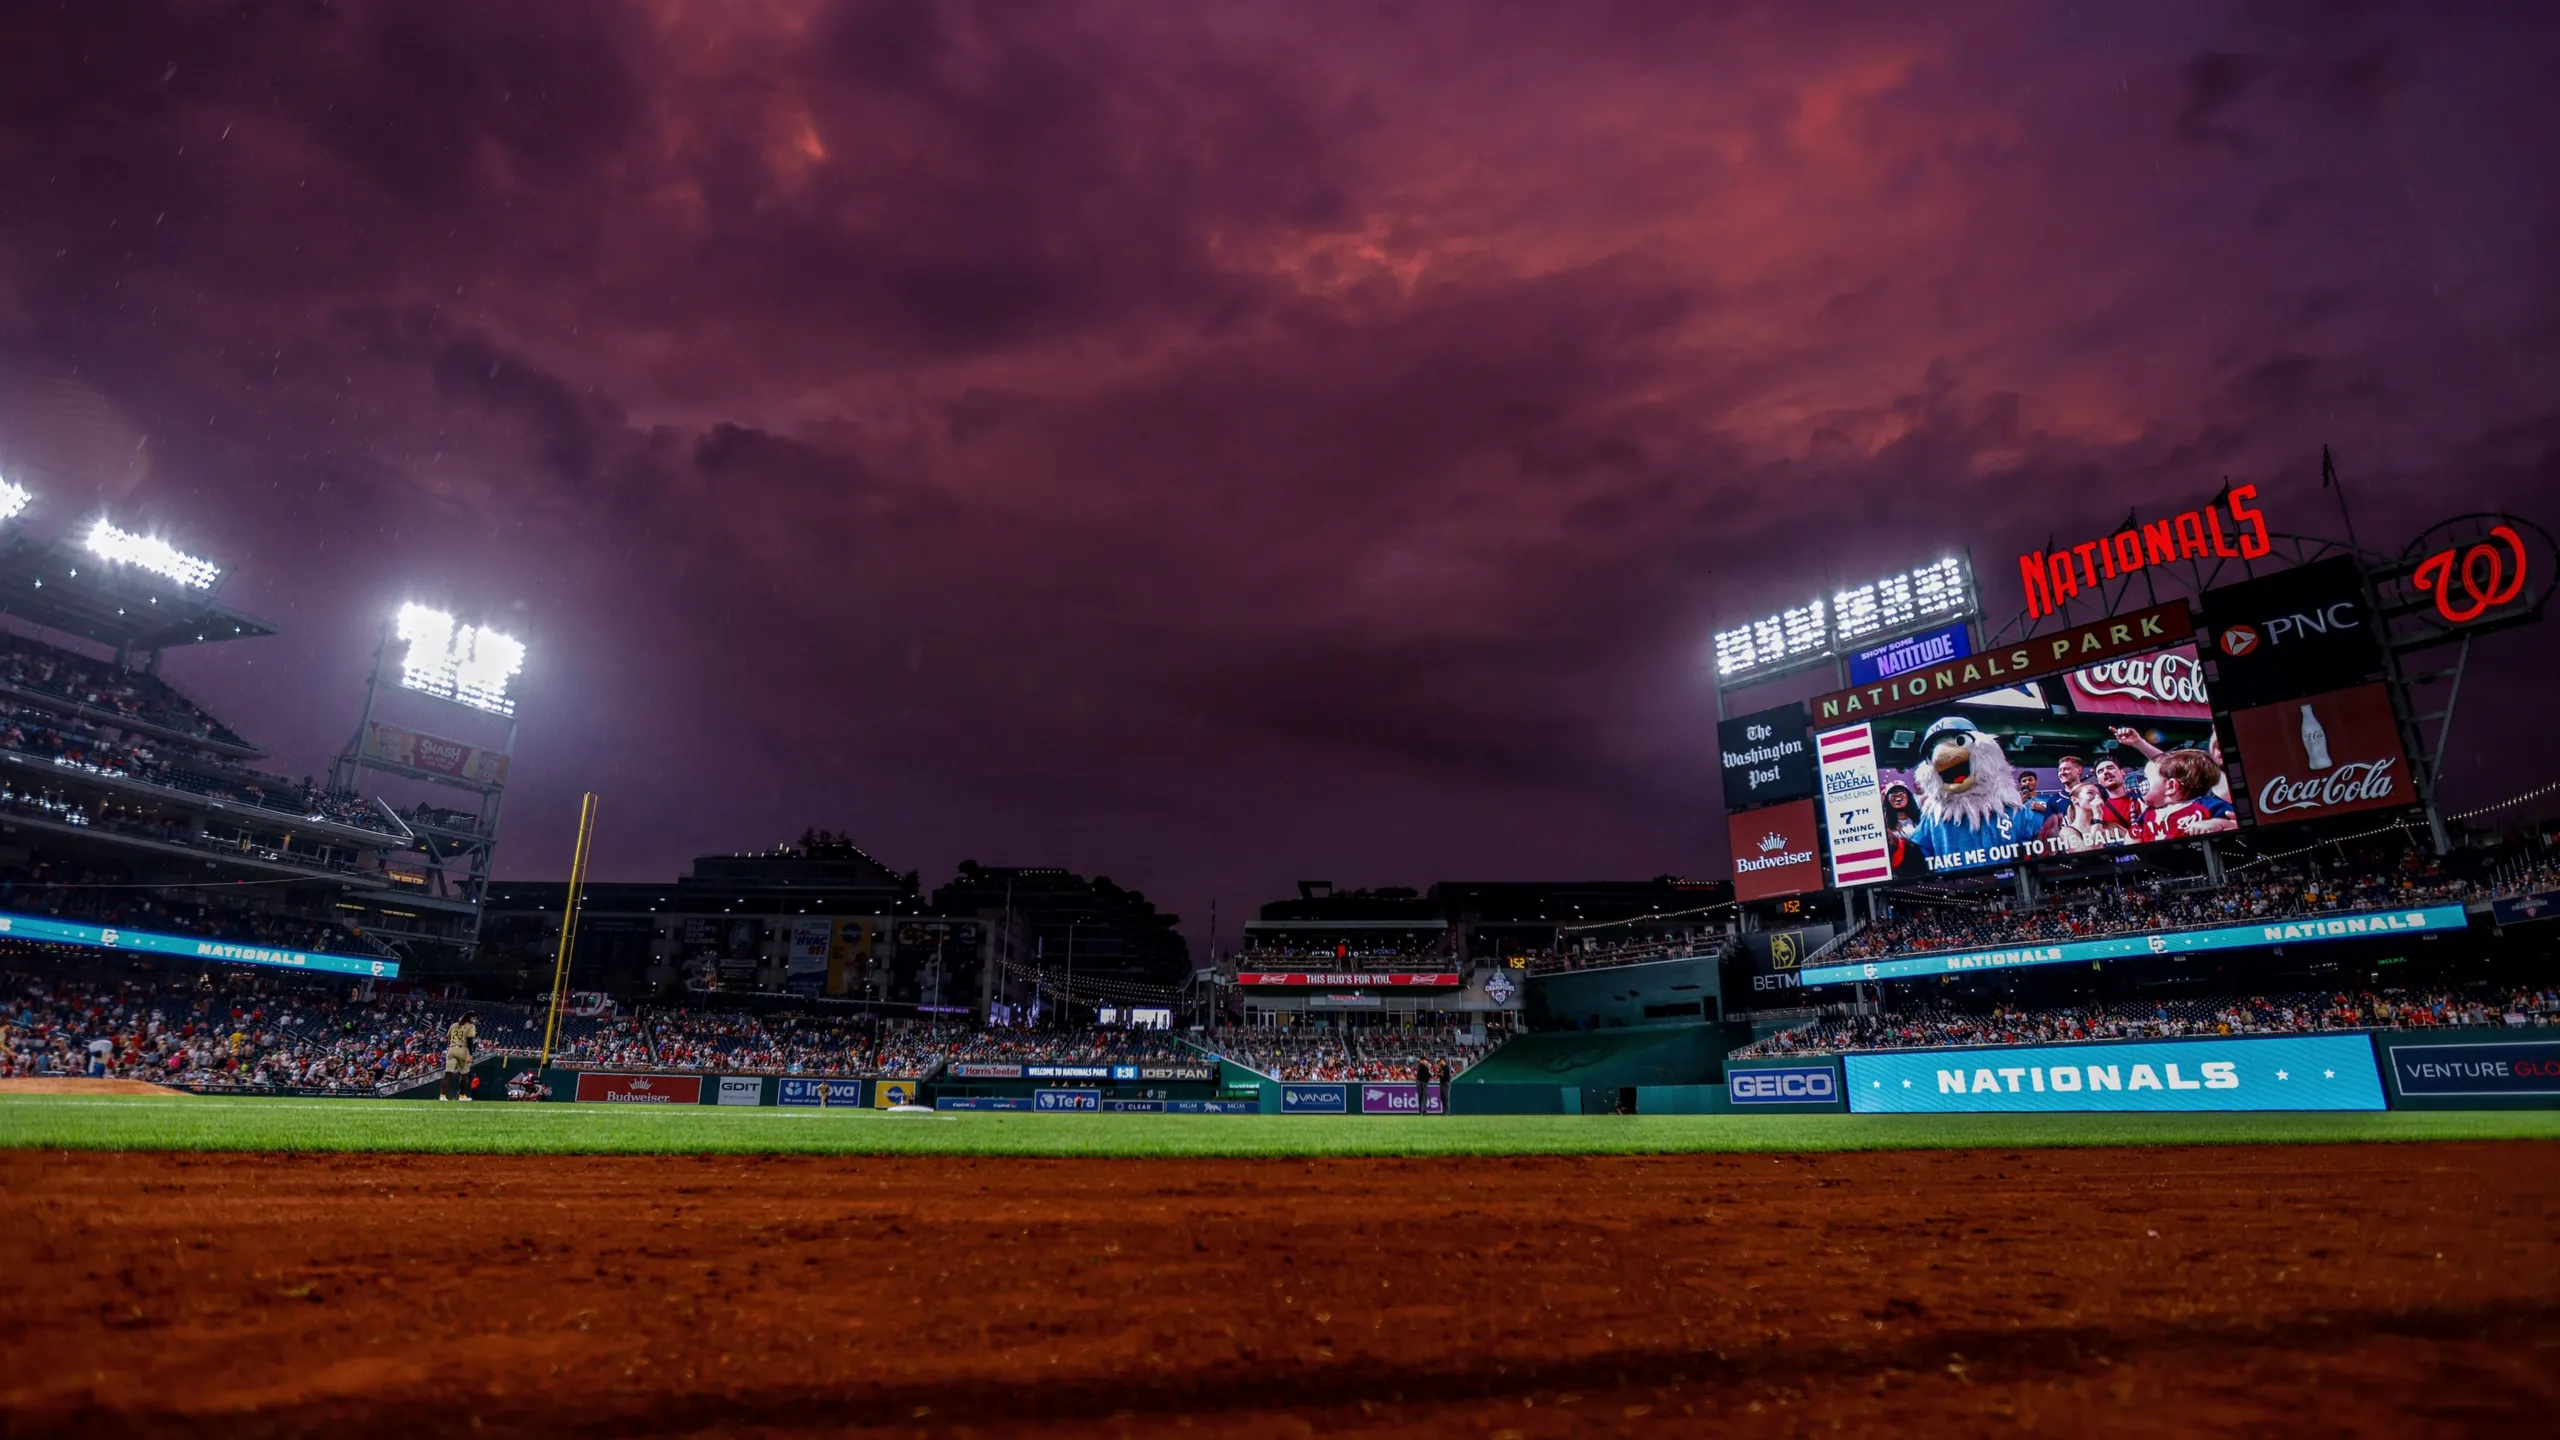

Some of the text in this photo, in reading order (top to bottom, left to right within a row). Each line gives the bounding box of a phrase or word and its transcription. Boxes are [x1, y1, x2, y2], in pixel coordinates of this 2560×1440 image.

[2019, 484, 2271, 620] NATIONALS
[2413, 525, 2527, 623] W
[2261, 602, 2359, 645] PNC
[1861, 637, 1914, 660] SHOW SOME
[1877, 634, 1954, 677] NATITUDE
[1823, 614, 2165, 719] NATIONALS PARK
[2075, 654, 2208, 704] Coca-Col
[1747, 724, 1772, 741] The
[1722, 741, 1803, 768] Washington
[1748, 765, 1781, 790] Post
[1825, 769, 1855, 783] NAVY
[1827, 775, 1874, 792] FEDERAL
[2259, 757, 2396, 814] Coca-Cola
[1828, 788, 1877, 804] Credit Union
[1840, 808, 1869, 825] 7TH
[1833, 831, 1882, 846] STRETCH
[1839, 824, 1875, 835] INNING
[1925, 854, 1962, 871] TAKE
[1965, 849, 1986, 865] ME
[1989, 843, 2020, 861] OUT
[2022, 840, 2045, 856] TO
[2047, 835, 2079, 853] THE
[2082, 827, 2125, 847] BALL
[1736, 851, 1813, 873] Budweiser
[2263, 912, 2427, 941] NATIONALS
[197, 943, 306, 966] NATIONALS
[1947, 948, 2062, 970] NATIONALS
[1306, 975, 1392, 984] THIS BUD'S FOR YOU.
[452, 1030, 464, 1040] 23
[965, 1066, 1020, 1076] Harris Teeter
[1029, 1067, 1107, 1077] WELCOME TO NATIONALS PARK
[1176, 1069, 1208, 1079] FAN
[1937, 1061, 2239, 1094] NATIONALS
[2406, 1061, 2509, 1078] VENTURE
[721, 1083, 760, 1091] GDIT
[806, 1082, 855, 1097] Inova
[1733, 1074, 1832, 1097] GEICO
[1298, 1093, 1341, 1102] VANDA
